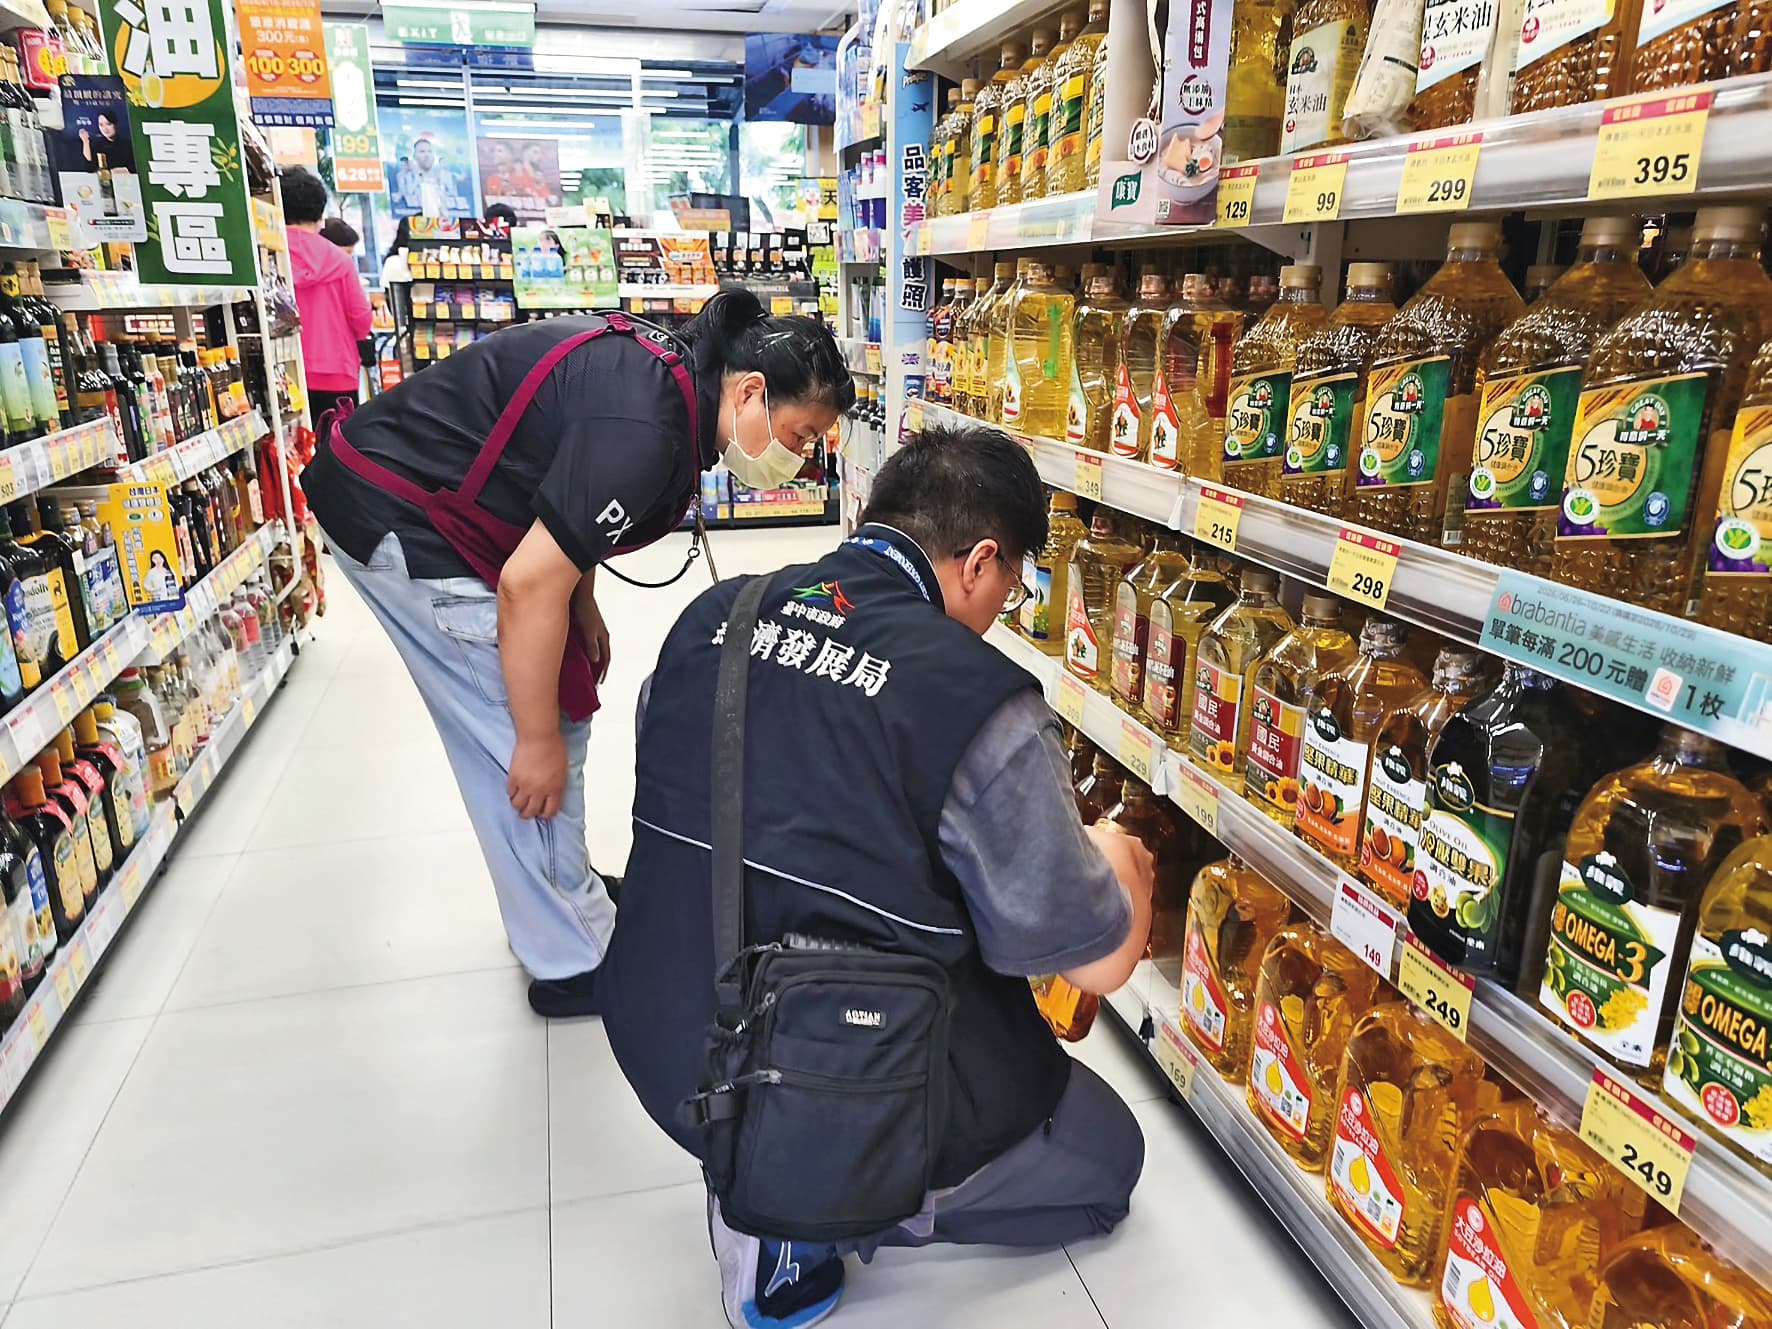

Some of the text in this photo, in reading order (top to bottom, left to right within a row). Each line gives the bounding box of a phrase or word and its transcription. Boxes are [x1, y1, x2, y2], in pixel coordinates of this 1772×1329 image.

[397, 27, 438, 39] EXIT
[1433, 1, 1492, 39] 玄米油
[250, 57, 325, 75] 100 300
[1633, 153, 1690, 185] 395
[1316, 192, 1336, 212] 99
[1428, 178, 1466, 203] 299
[1226, 201, 1247, 219] 129
[901, 144, 926, 310] 品客美護照
[1368, 413, 1406, 443] 5珍寶
[1619, 430, 1667, 442] 得意的一天
[1480, 429, 1528, 462] 5珍寶
[1578, 445, 1640, 484] 5珍寶
[1085, 480, 1099, 495] 349
[595, 498, 634, 544] PX
[1211, 523, 1233, 544] 215
[1352, 573, 1383, 599] 298
[1512, 593, 1737, 686] brabantia 美感生活 收納新鮮
[712, 619, 892, 697] 濟發展局
[1489, 618, 1726, 720] 單筆每滿 200 元贈 1 枚
[1256, 724, 1280, 752] 國民
[1131, 754, 1148, 776] 229
[1304, 743, 1359, 786] 堅果精華
[1196, 805, 1213, 828] 199
[1370, 784, 1422, 831] 堅果精華
[1429, 820, 1469, 850] OLIVE OIL
[1421, 828, 1490, 886] 冷壓雙果
[1430, 863, 1456, 887] 調合油
[1364, 944, 1381, 967] 149
[1565, 912, 1649, 984] OMEGA-3
[1425, 989, 1460, 1028] 249
[1169, 1060, 1187, 1089] 169
[1342, 1103, 1379, 1156] 大豆沙拉油
[1621, 1143, 1672, 1196] 249
[1455, 1215, 1507, 1280] 大豆沙拉油
